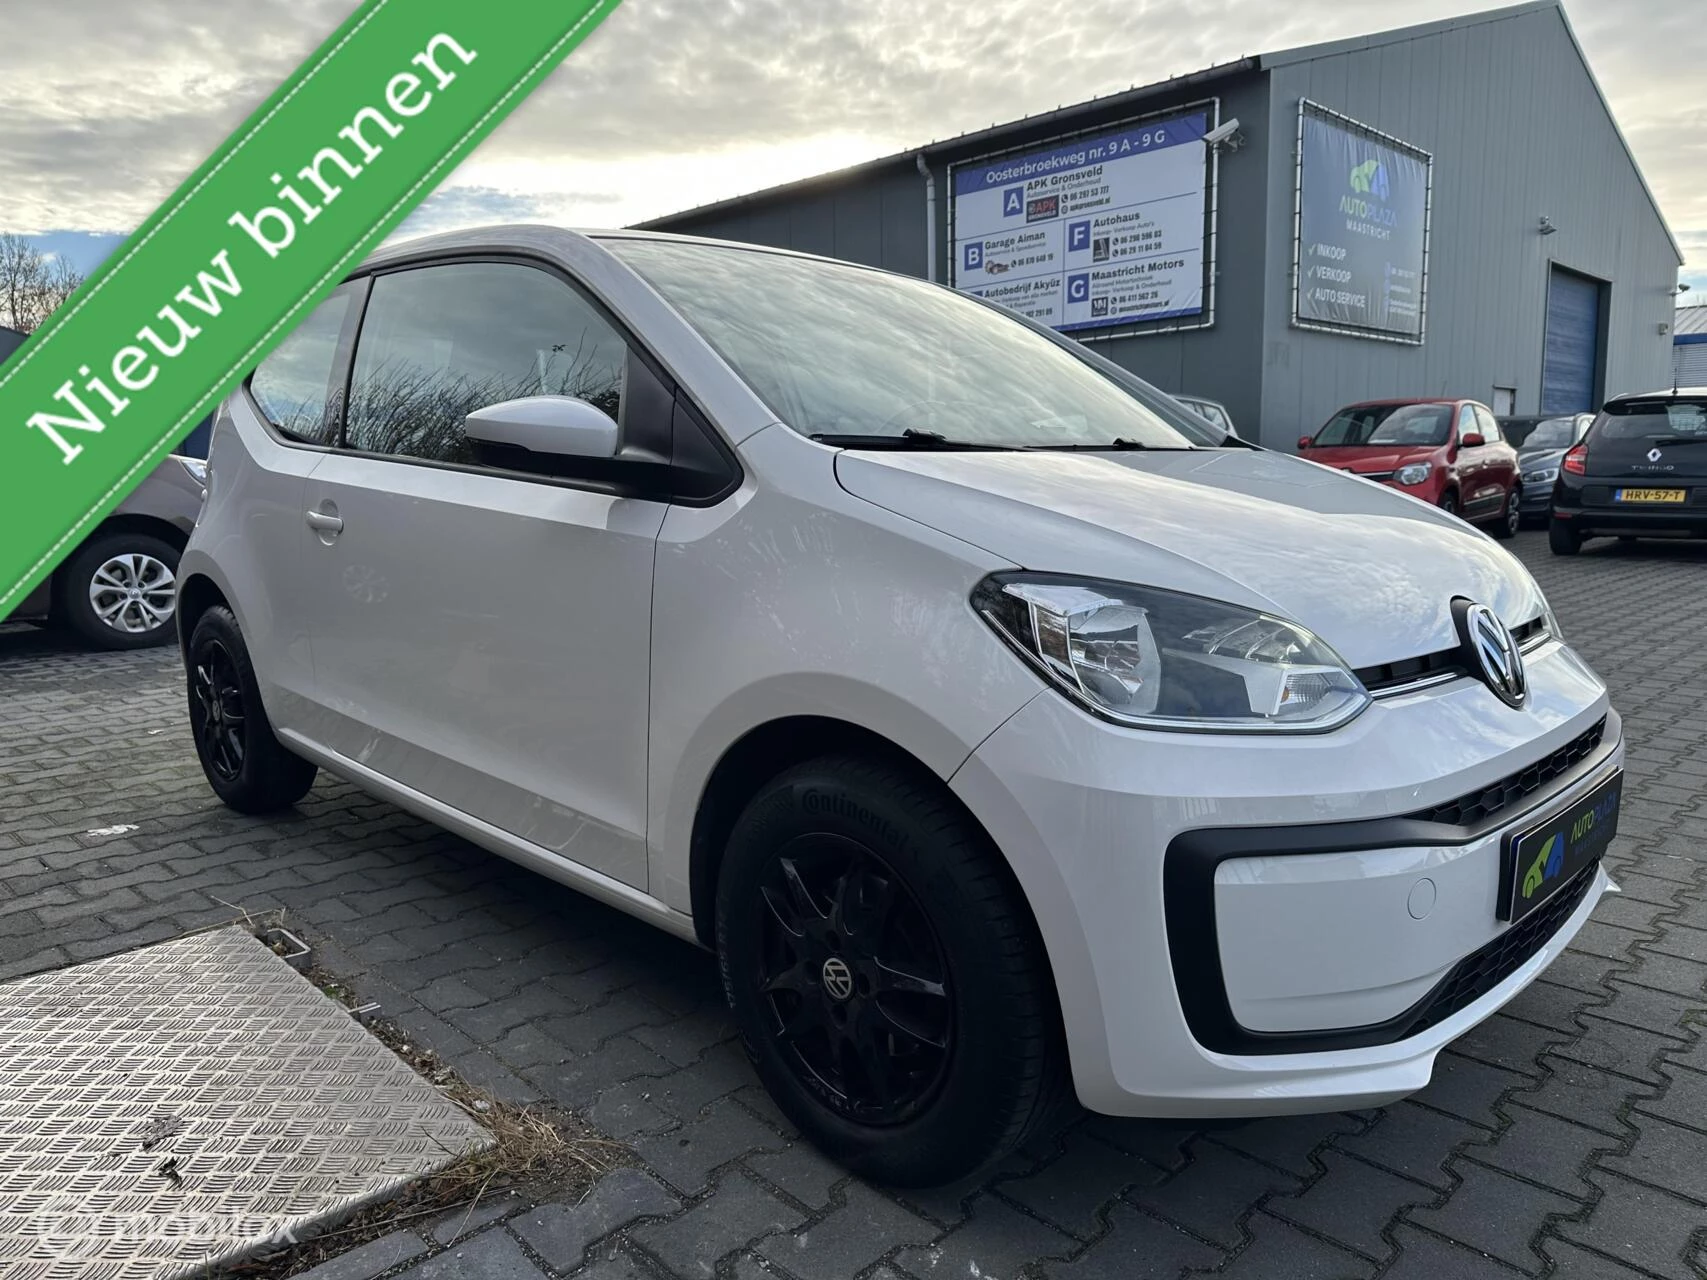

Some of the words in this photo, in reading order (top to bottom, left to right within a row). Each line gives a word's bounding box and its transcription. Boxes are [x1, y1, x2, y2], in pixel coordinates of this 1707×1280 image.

[986, 152, 1085, 184] Oosterbroekweg
[1089, 148, 1106, 161] nr.
[1109, 142, 1118, 155] 9
[1120, 139, 1131, 153] A
[1142, 133, 1151, 146] 9
[1154, 130, 1166, 143] G
[1027, 178, 1048, 191] APK
[1051, 165, 1103, 185] Gronsveld
[1007, 192, 1020, 212] A
[1093, 212, 1140, 228] Autohaus
[985, 238, 1015, 250] Garage
[1017, 232, 1046, 244] Aiman
[1074, 226, 1085, 246] F
[968, 248, 980, 266] B
[1317, 243, 1347, 260] INKOOP
[1092, 265, 1145, 281] Maastricht
[1148, 259, 1185, 272] Motors
[1316, 265, 1352, 283] VERKOOP
[984, 282, 1032, 298] Autobedrijf
[1033, 279, 1060, 291] Akyüz
[1071, 280, 1085, 298] G
[1315, 287, 1337, 302] AUTO
[1337, 290, 1366, 308] SERVICE
[1626, 490, 1681, 500] HRV-57-T
[801, 788, 910, 852] Continental
